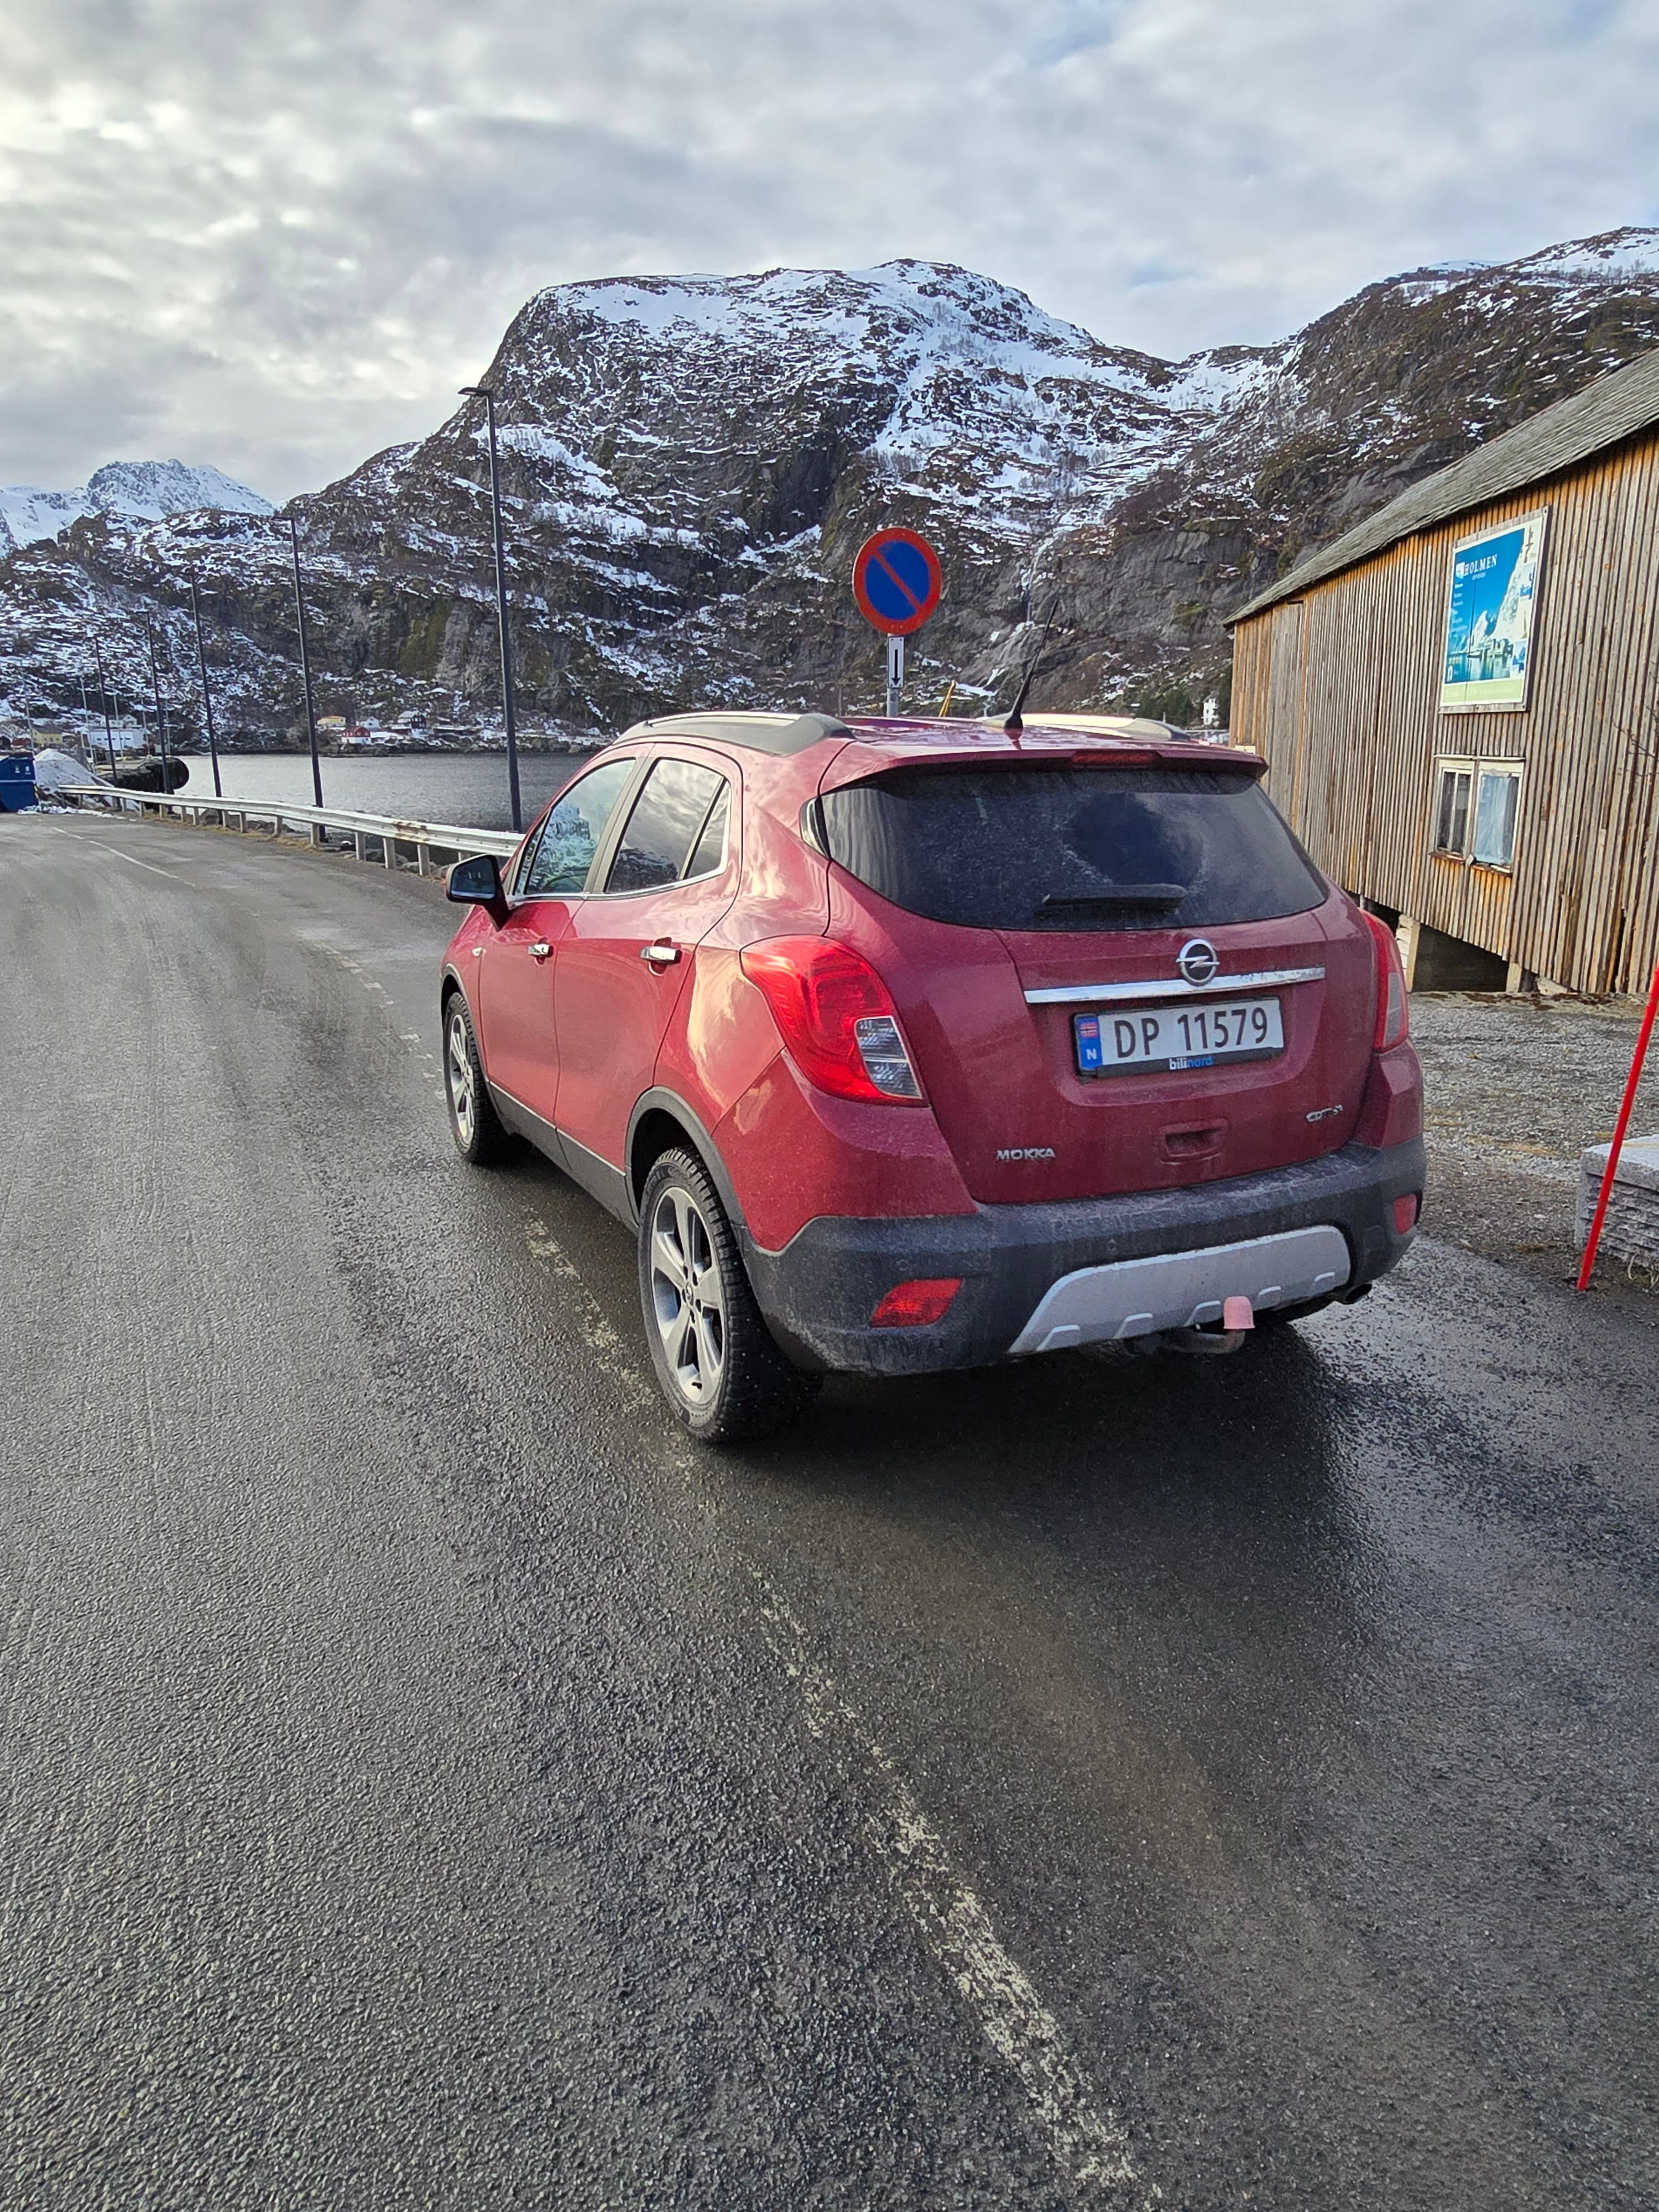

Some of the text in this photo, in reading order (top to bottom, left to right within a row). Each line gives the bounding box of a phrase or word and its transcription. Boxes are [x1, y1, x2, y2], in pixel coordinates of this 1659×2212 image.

[1464, 554, 1498, 576] HOLMEN
[1114, 1007, 1267, 1058] DP 11579
[1086, 1048, 1097, 1060] N
[1168, 1055, 1213, 1071] bilinord
[996, 1147, 1057, 1161] MOKKA
